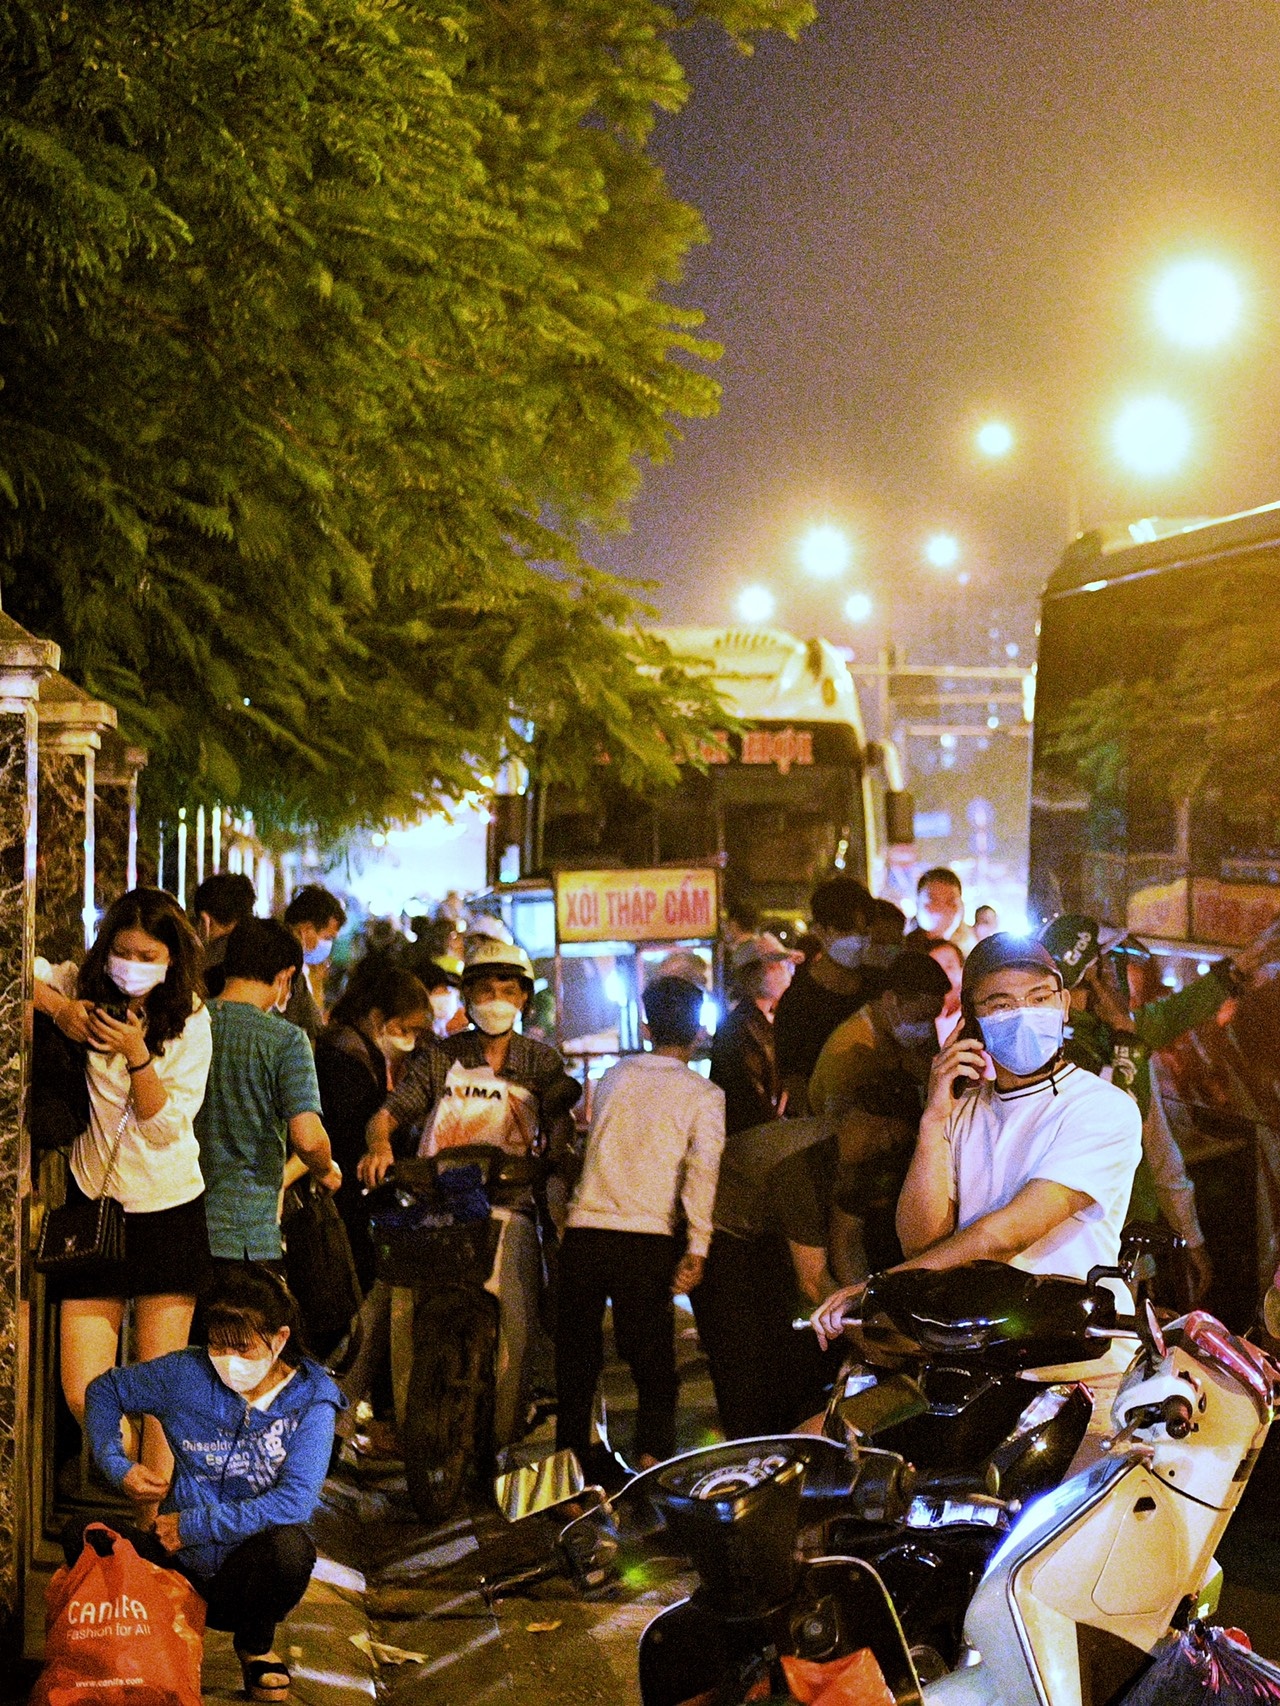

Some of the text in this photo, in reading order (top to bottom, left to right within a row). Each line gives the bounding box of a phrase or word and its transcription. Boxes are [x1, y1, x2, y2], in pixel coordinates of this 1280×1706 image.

[66, 1623, 151, 1641] Fashion for All
[75, 1676, 145, 1689] www.canifa.com
